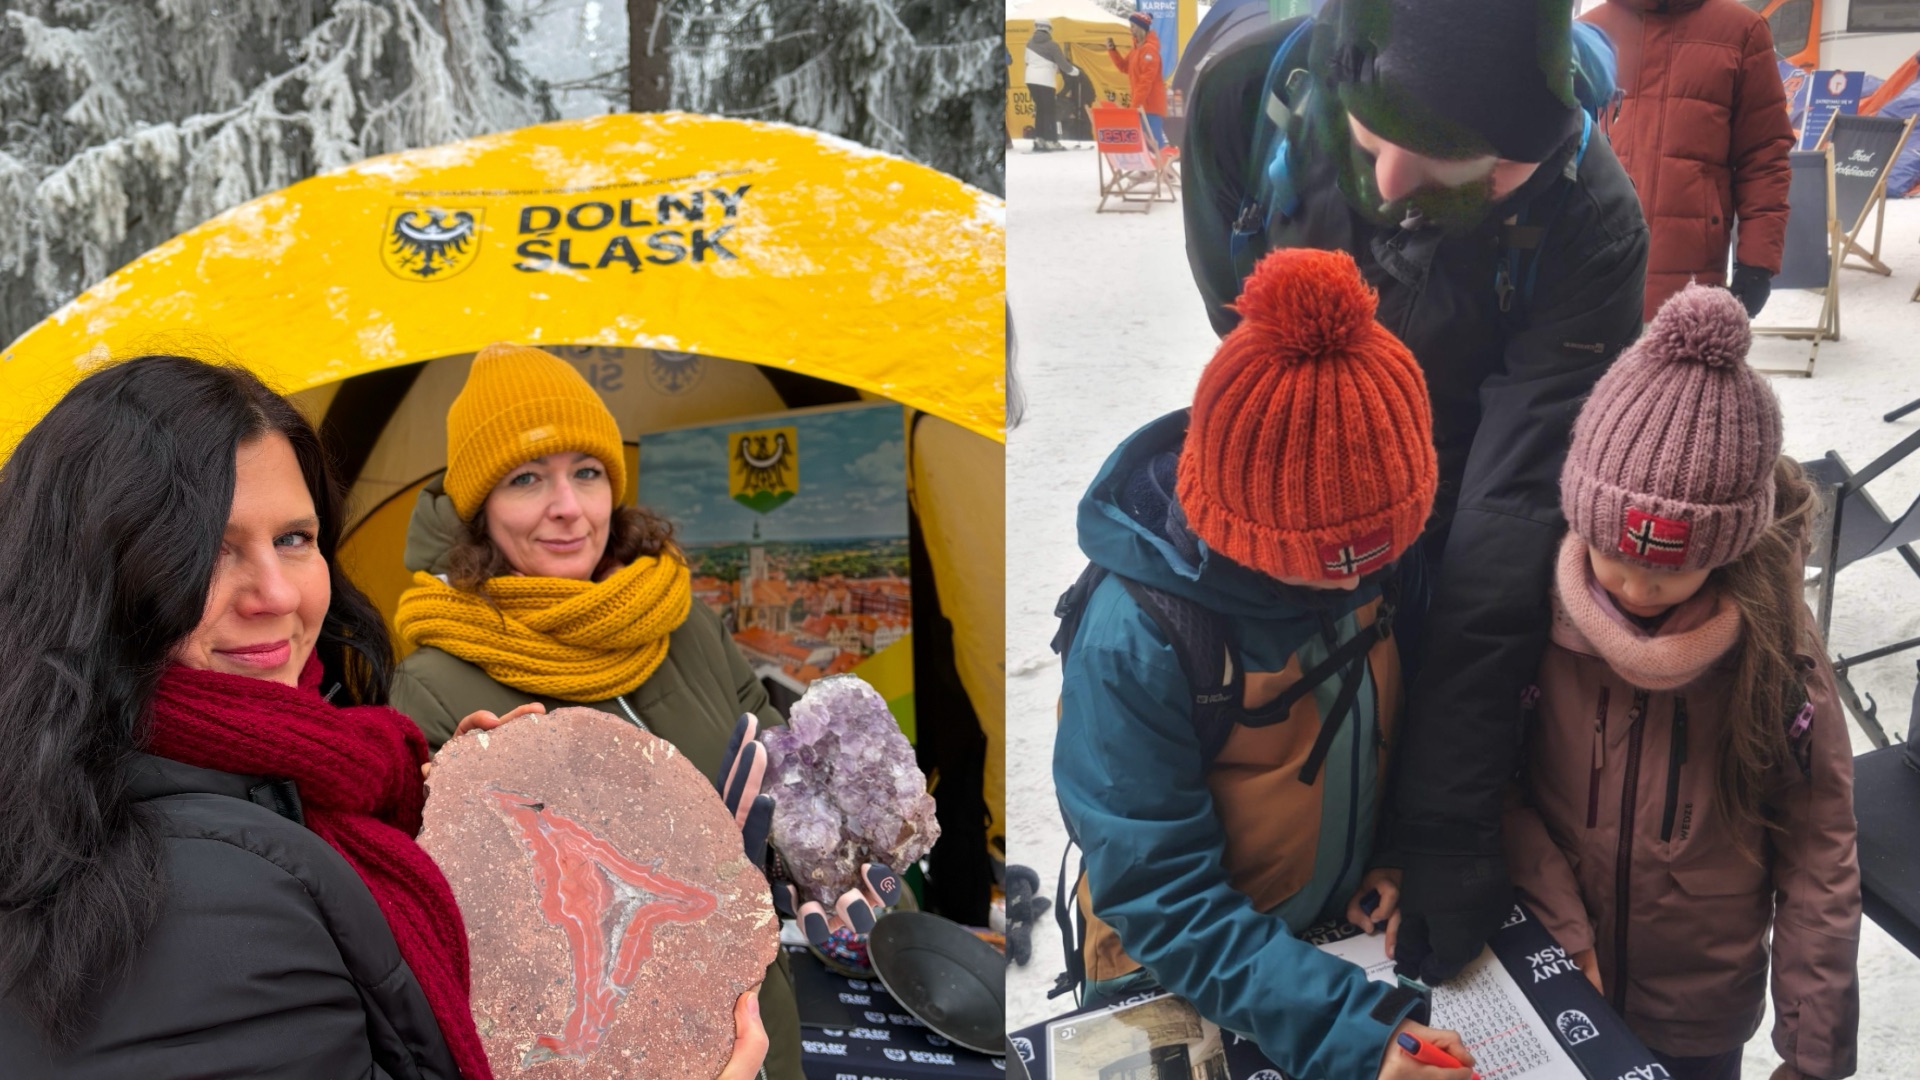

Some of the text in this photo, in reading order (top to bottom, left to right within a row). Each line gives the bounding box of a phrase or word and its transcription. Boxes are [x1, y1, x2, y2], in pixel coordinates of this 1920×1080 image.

[1141, 1, 1176, 10] KARPAC
[518, 184, 752, 235] DOLNY
[512, 224, 740, 274] ŚLĄSK
[1679, 802, 1693, 841] WEDZE
